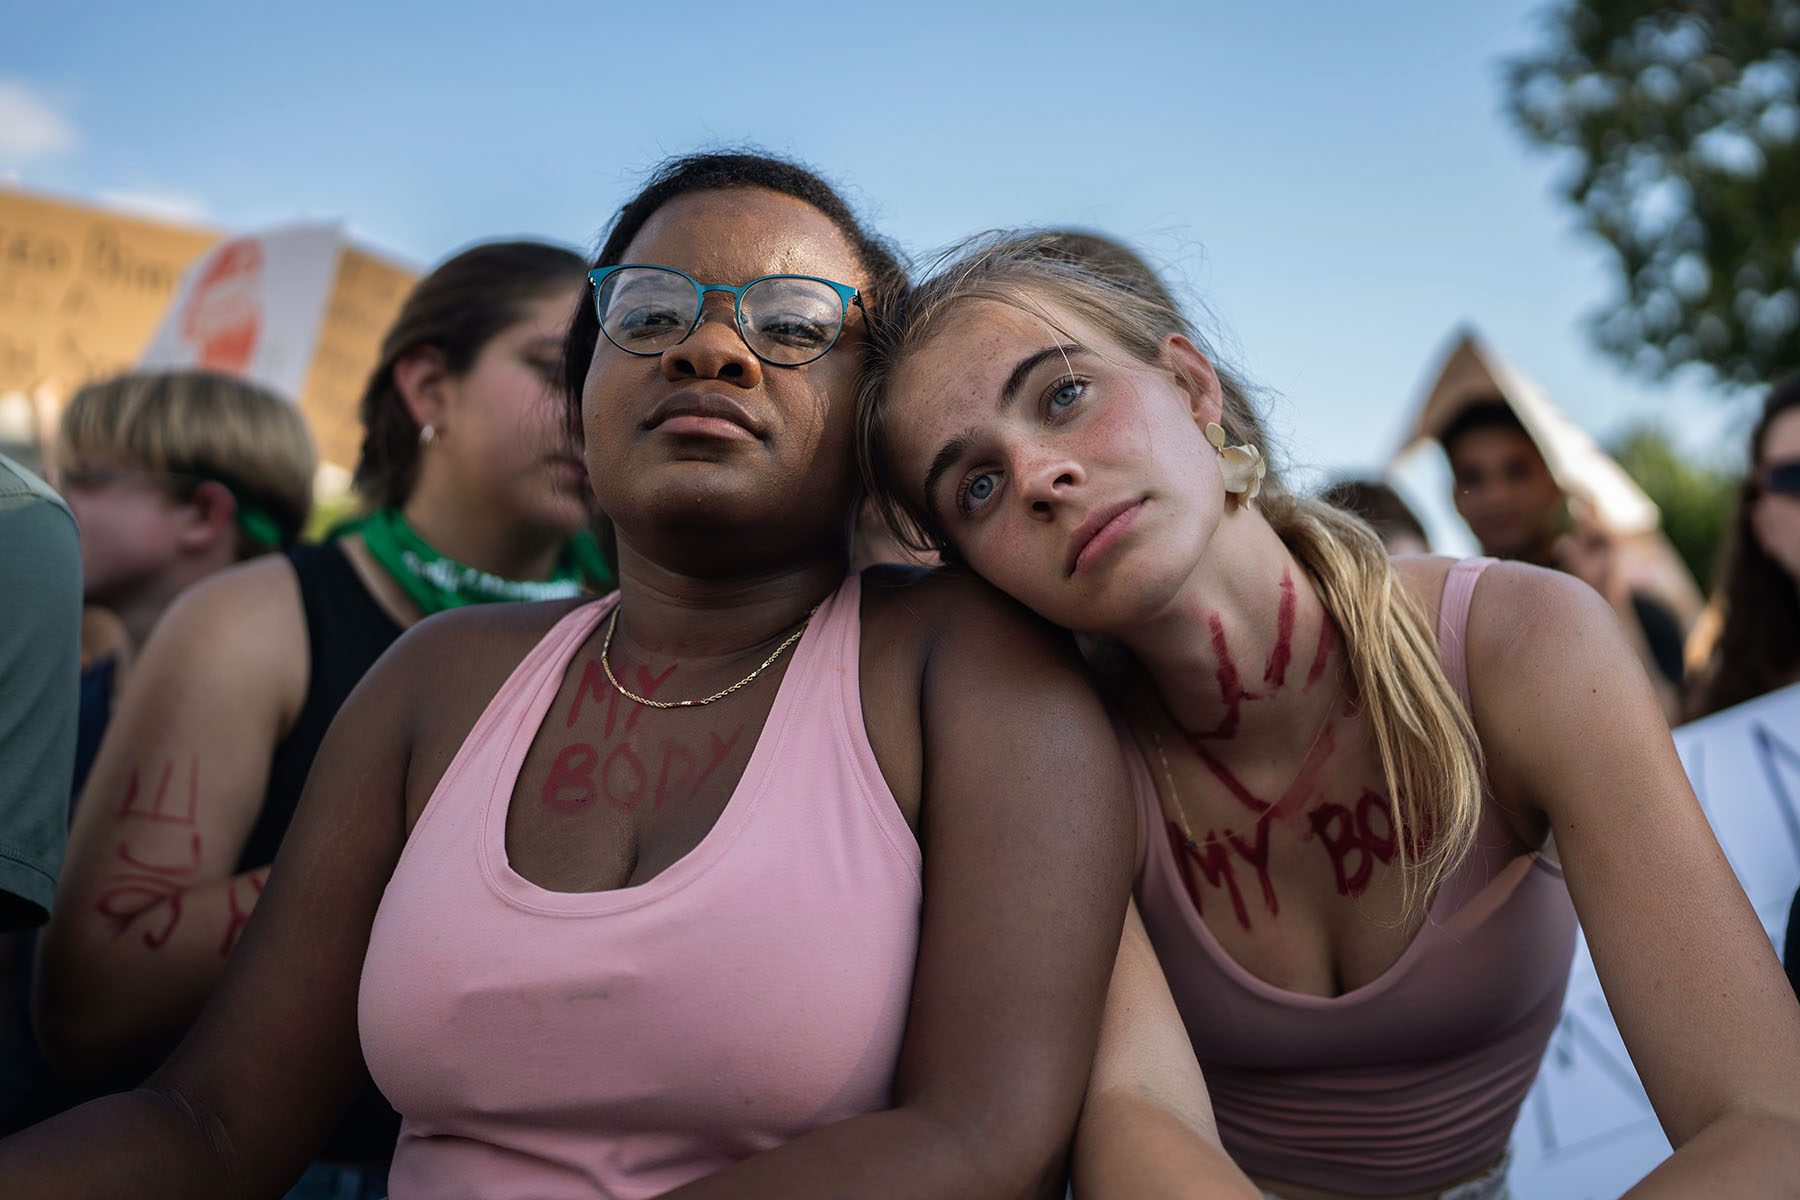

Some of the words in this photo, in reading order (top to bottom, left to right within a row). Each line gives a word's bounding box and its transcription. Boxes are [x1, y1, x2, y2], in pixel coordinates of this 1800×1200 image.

[566, 659, 679, 740] MY
[541, 717, 749, 816] BODY
[1169, 811, 1280, 932] MY
[1309, 785, 1436, 897] BO
